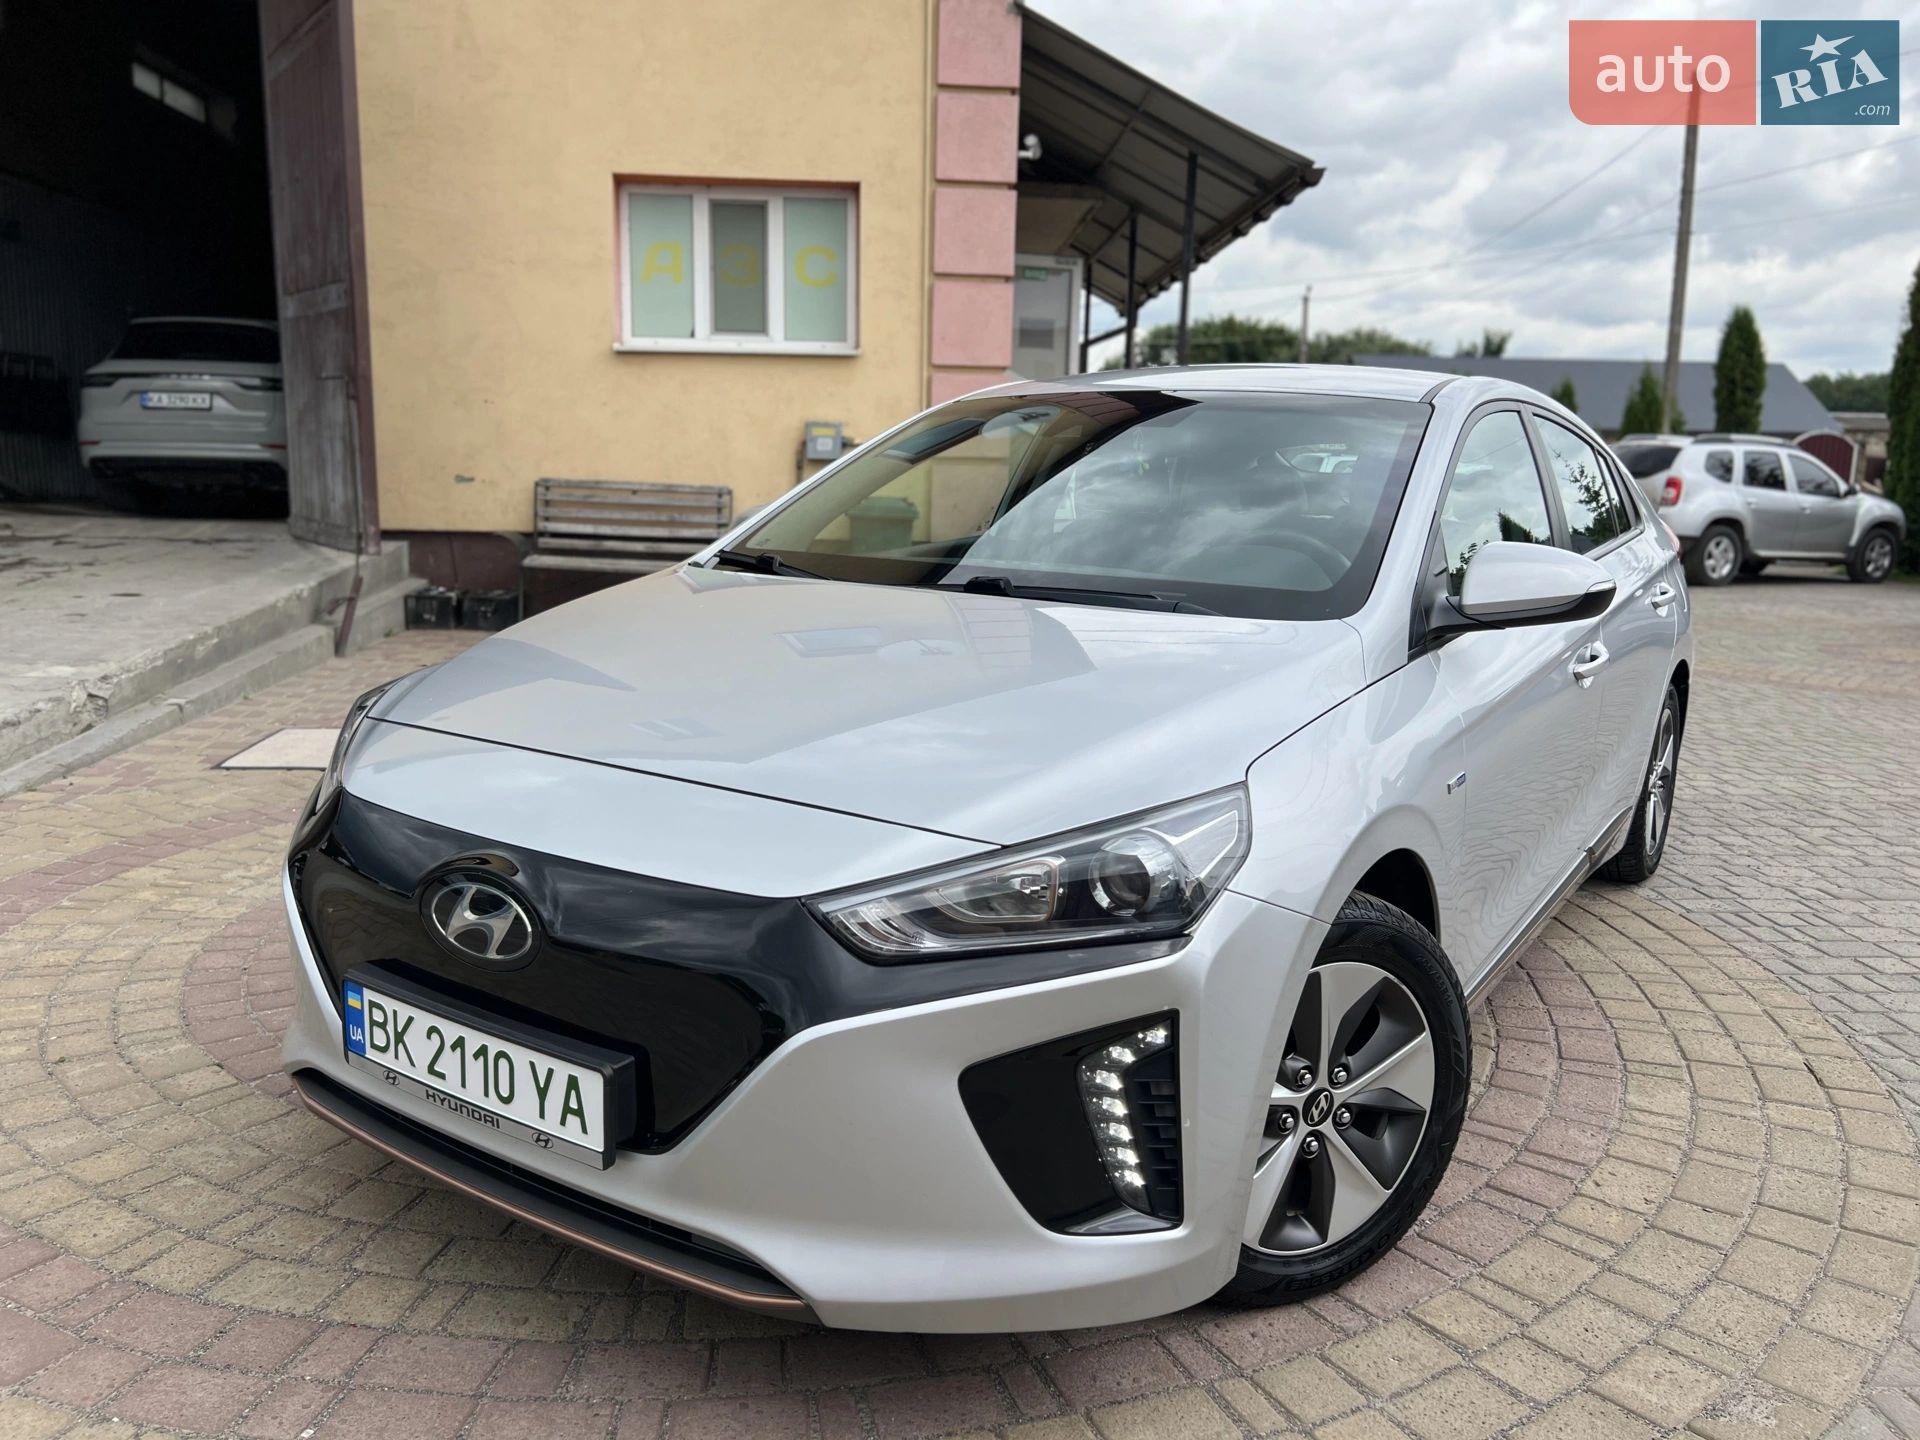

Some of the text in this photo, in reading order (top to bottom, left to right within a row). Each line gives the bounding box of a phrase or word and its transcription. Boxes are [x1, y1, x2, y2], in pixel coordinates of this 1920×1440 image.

[350, 1024, 364, 1044] UA
[367, 998, 588, 1135] BK 2110 YA
[425, 1089, 501, 1130] HYUNDAI
